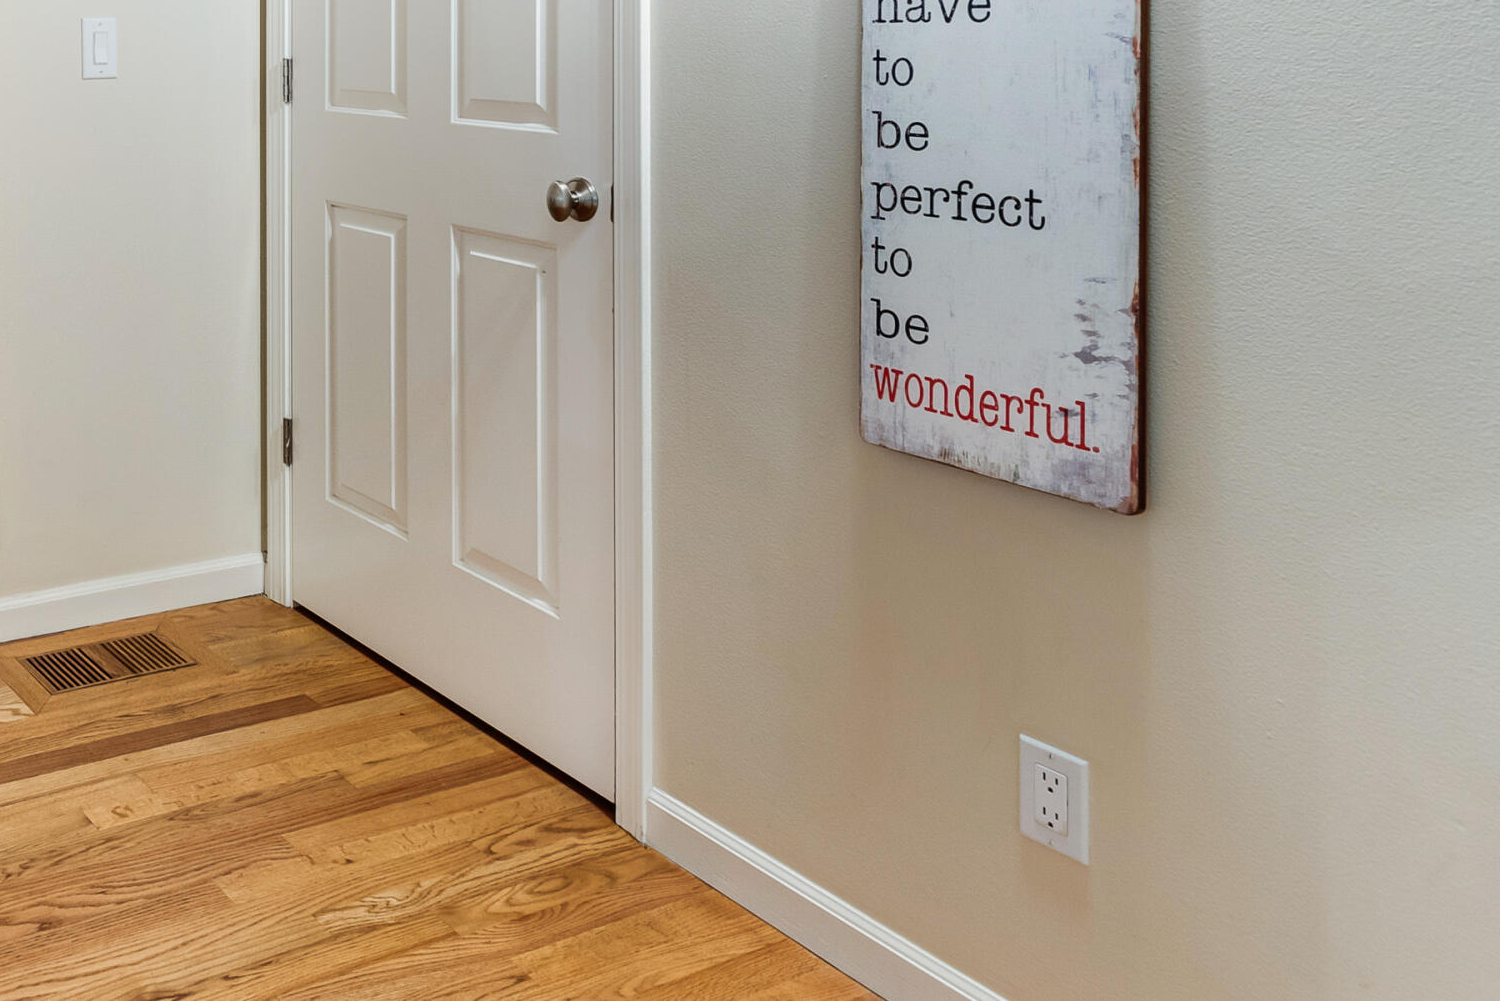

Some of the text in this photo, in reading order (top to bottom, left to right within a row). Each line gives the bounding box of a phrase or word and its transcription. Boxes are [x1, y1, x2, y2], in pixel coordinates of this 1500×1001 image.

[873, 48, 914, 87] to
[872, 110, 930, 152] be
[870, 179, 1046, 231] perfect
[871, 235, 913, 278] to
[870, 297, 930, 346] be
[870, 364, 1101, 453] wonderful.
